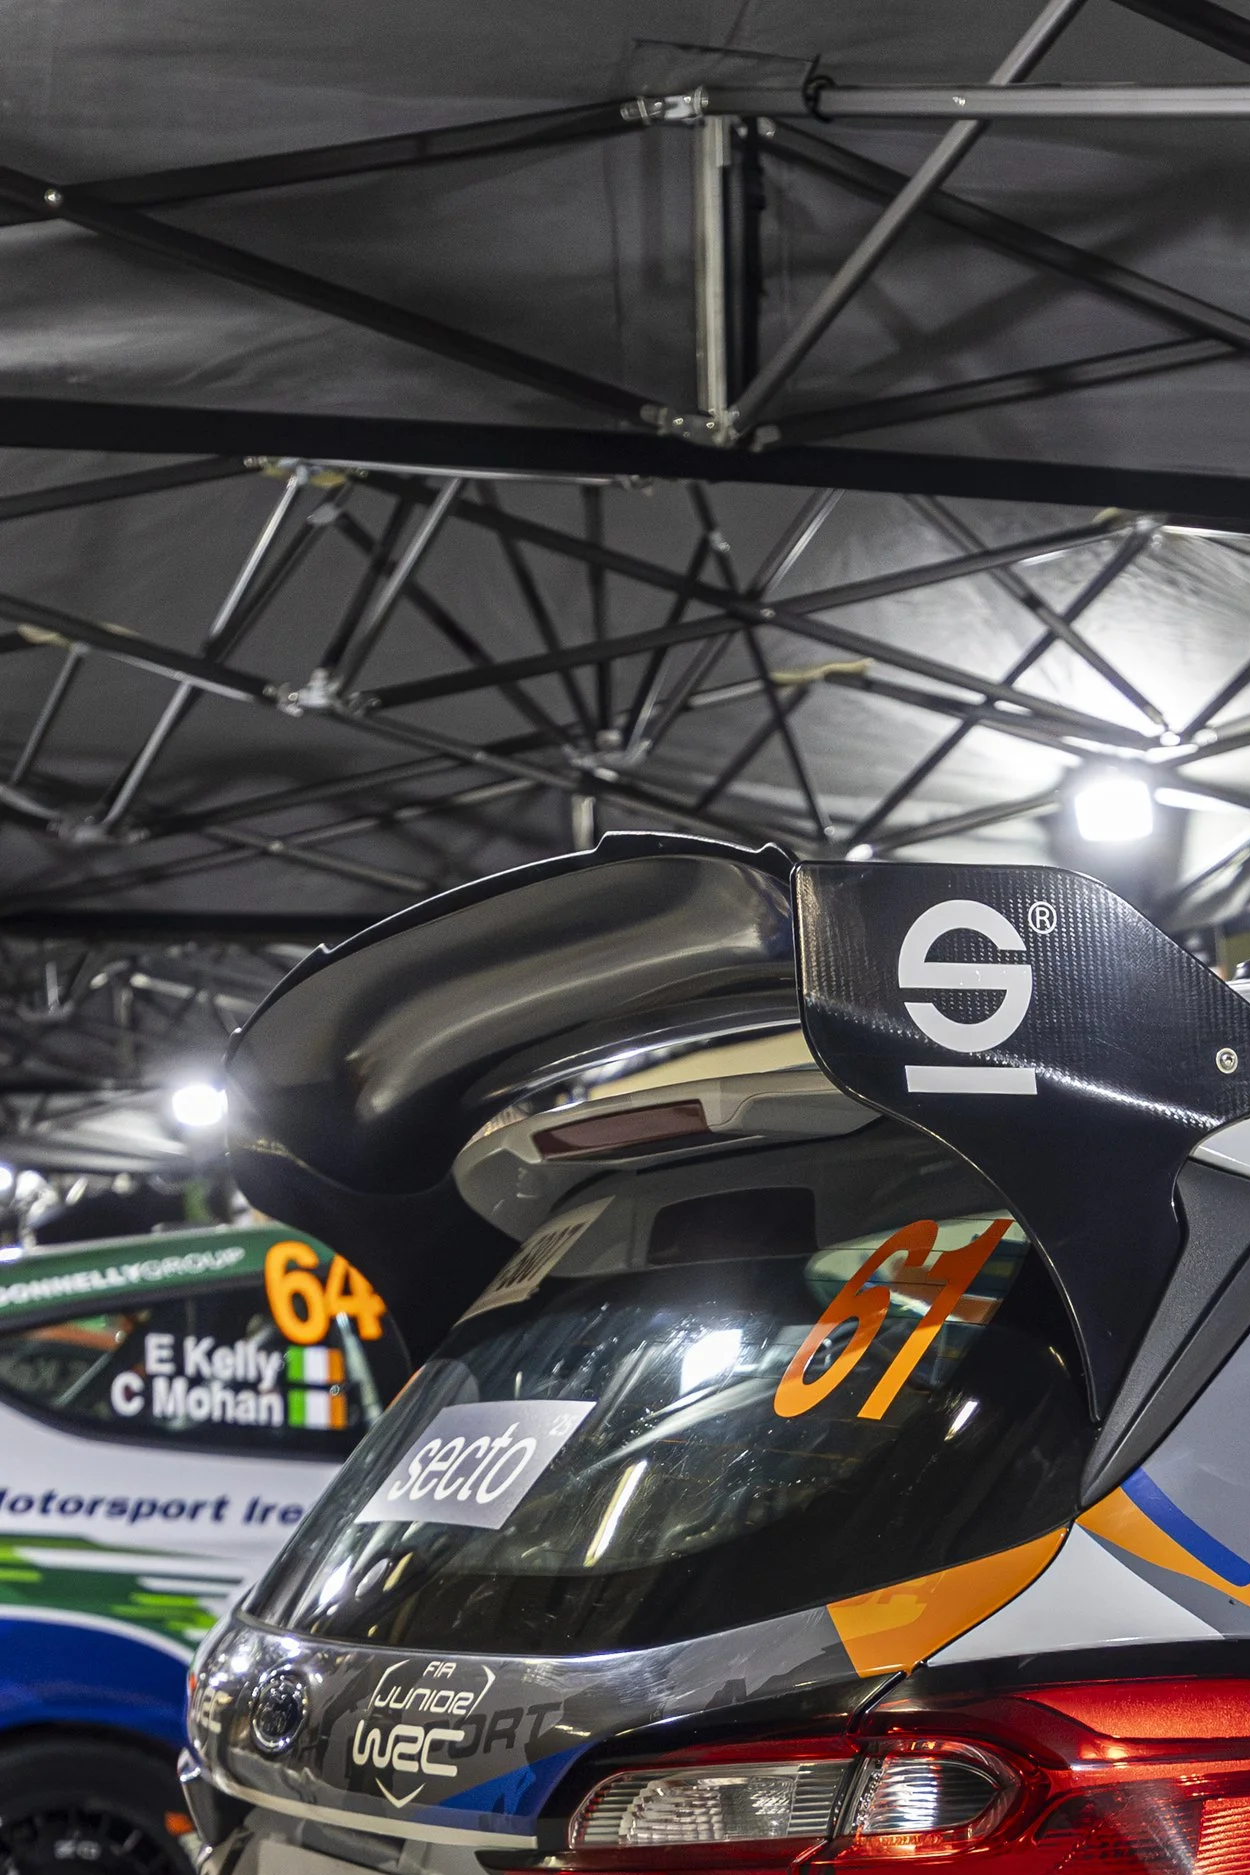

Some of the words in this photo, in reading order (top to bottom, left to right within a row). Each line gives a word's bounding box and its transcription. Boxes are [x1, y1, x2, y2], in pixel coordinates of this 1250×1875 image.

[264, 1240, 386, 1345] 64
[773, 1218, 1014, 1421] 61
[144, 1332, 174, 1376] E
[183, 1336, 283, 1391] Kelly
[111, 1370, 145, 1416] C
[152, 1376, 284, 1428] Mohan
[387, 1421, 537, 1504] secto
[0, 1486, 229, 1527] otorsport
[422, 1660, 457, 1679] FIA
[374, 1685, 475, 1716] JUNIOR
[352, 1718, 466, 1778] WRC
